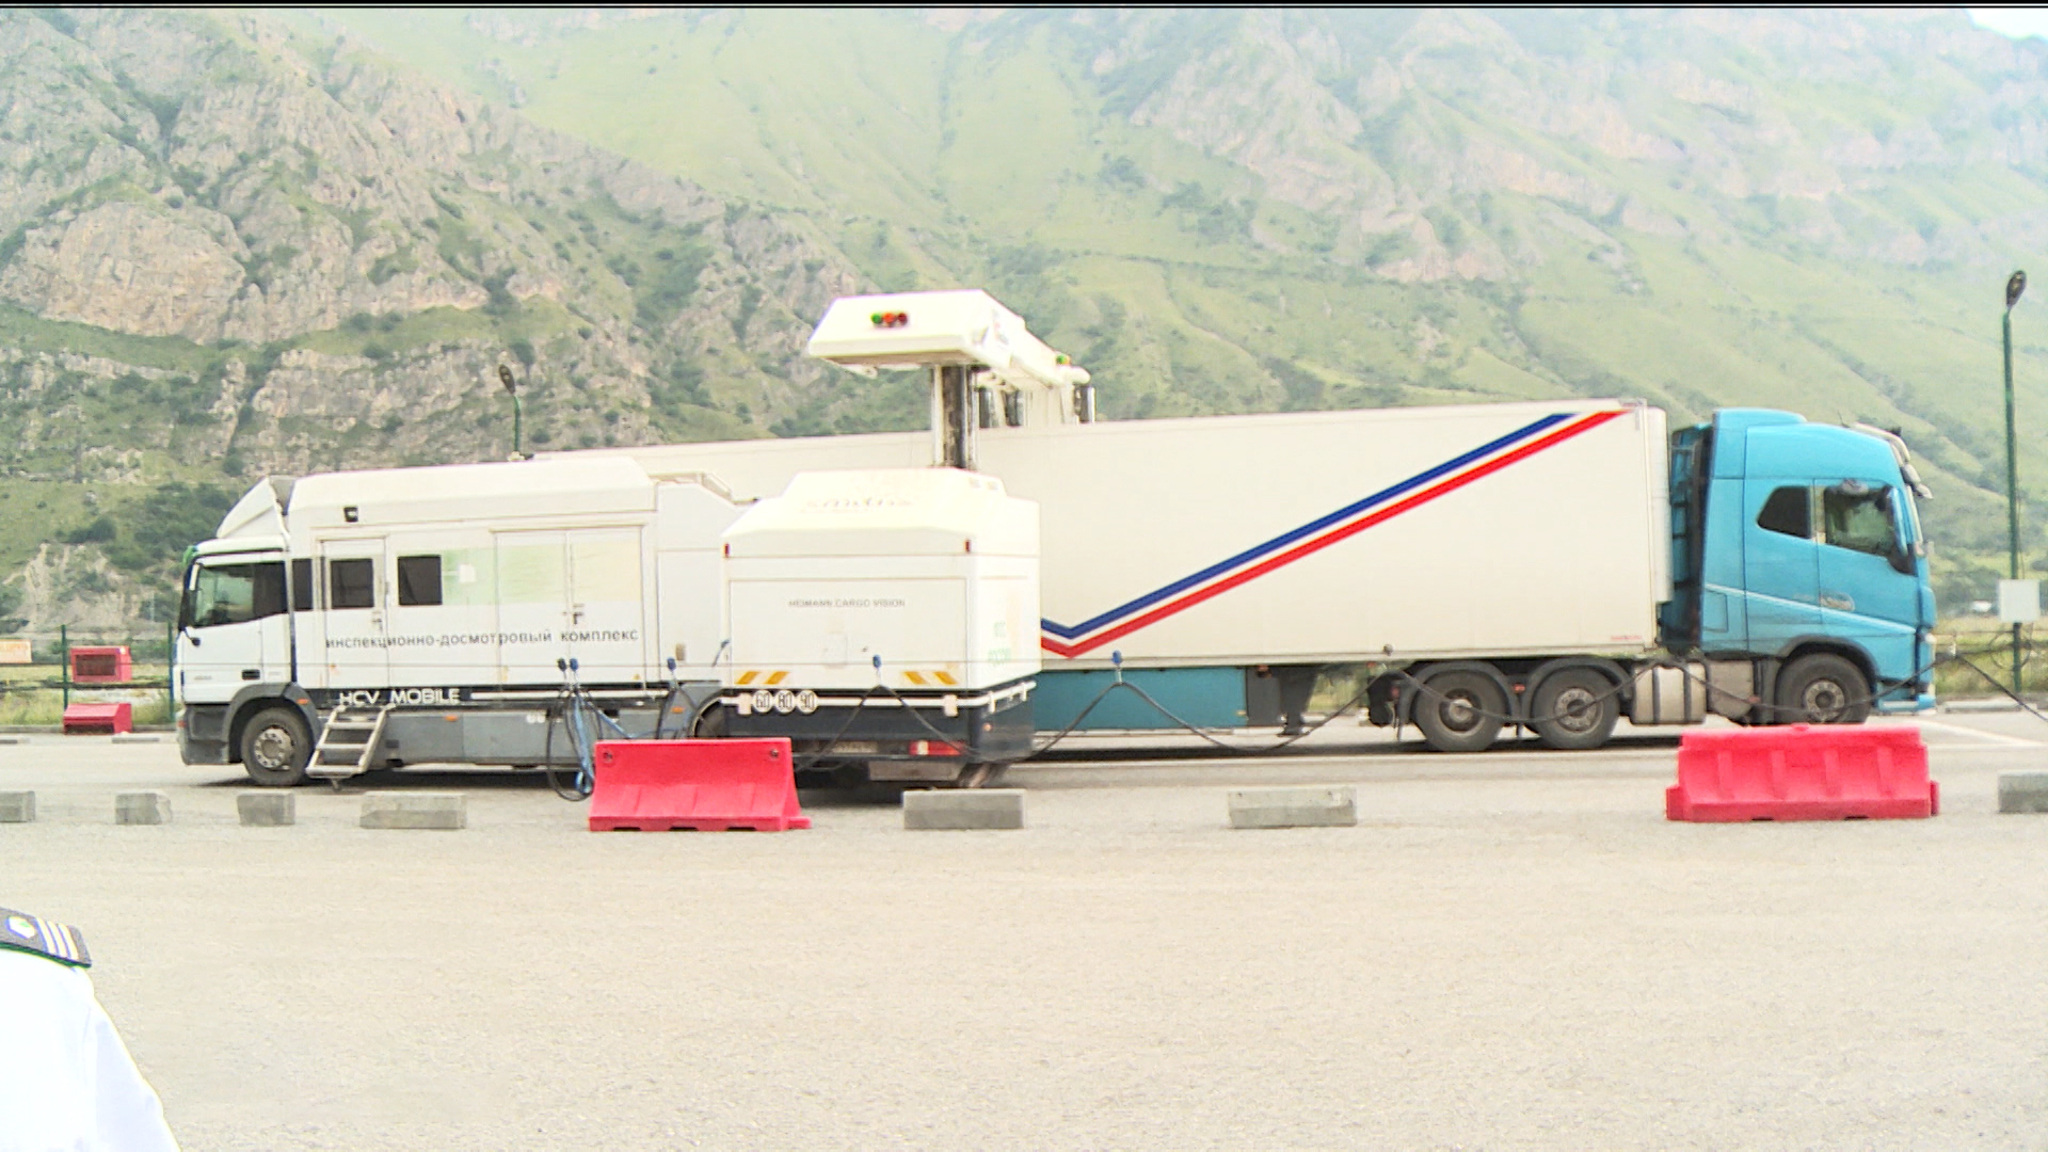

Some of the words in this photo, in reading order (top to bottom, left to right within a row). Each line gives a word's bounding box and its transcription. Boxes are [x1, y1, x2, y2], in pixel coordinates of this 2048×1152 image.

[835, 597, 870, 608] CARGO
[873, 597, 905, 608] VISION
[326, 629, 552, 648] инспекционно-досмотровый
[561, 629, 639, 642] комплекс
[339, 690, 380, 706] HCV
[390, 688, 460, 705] MOBILE
